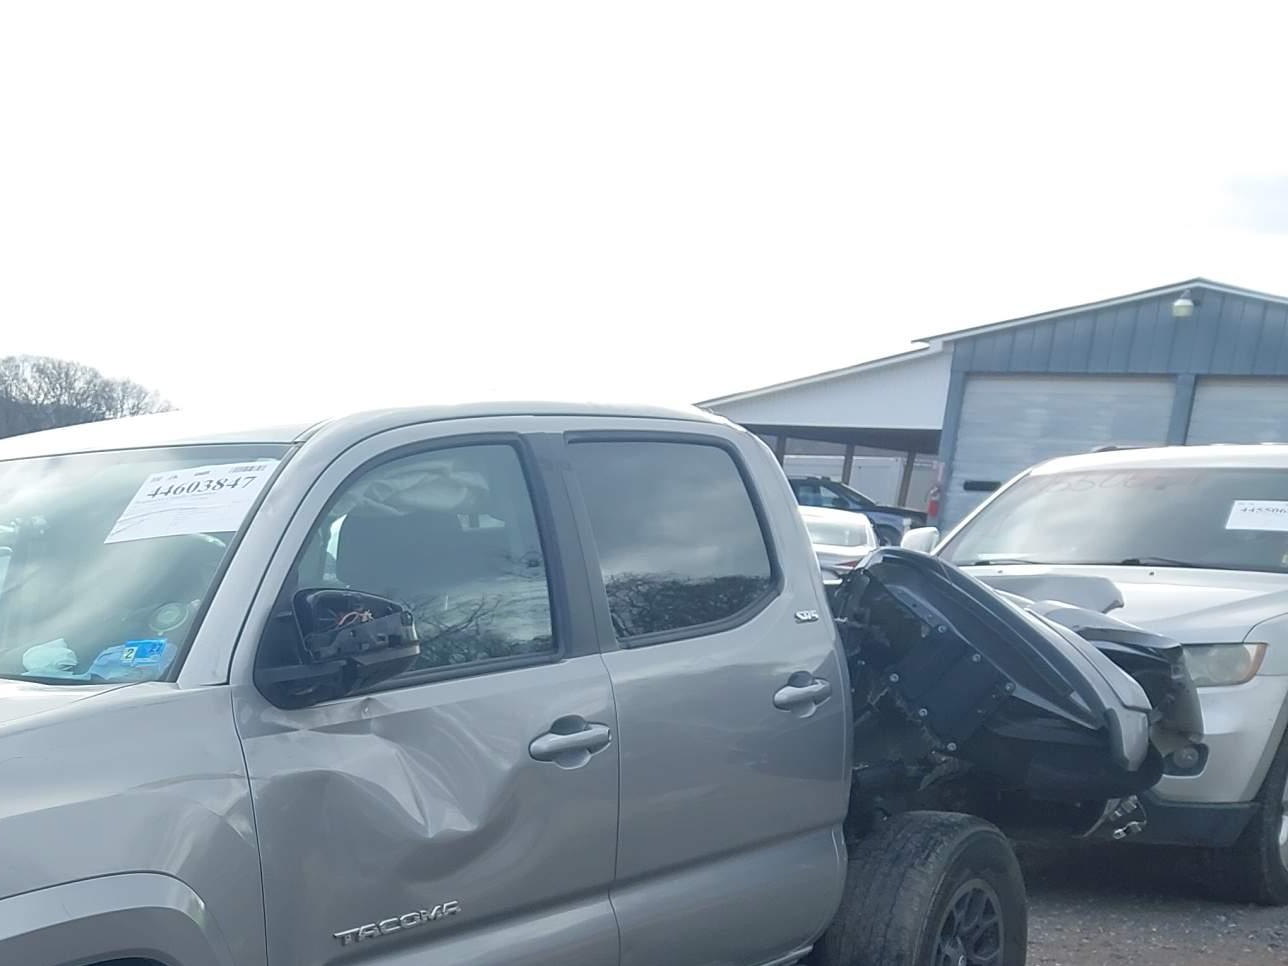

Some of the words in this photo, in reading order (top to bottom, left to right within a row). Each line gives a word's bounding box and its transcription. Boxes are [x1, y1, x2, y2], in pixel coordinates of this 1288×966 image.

[147, 475, 257, 499] 44603847
[125, 648, 135, 659] 2
[332, 900, 462, 945] TACOMA
